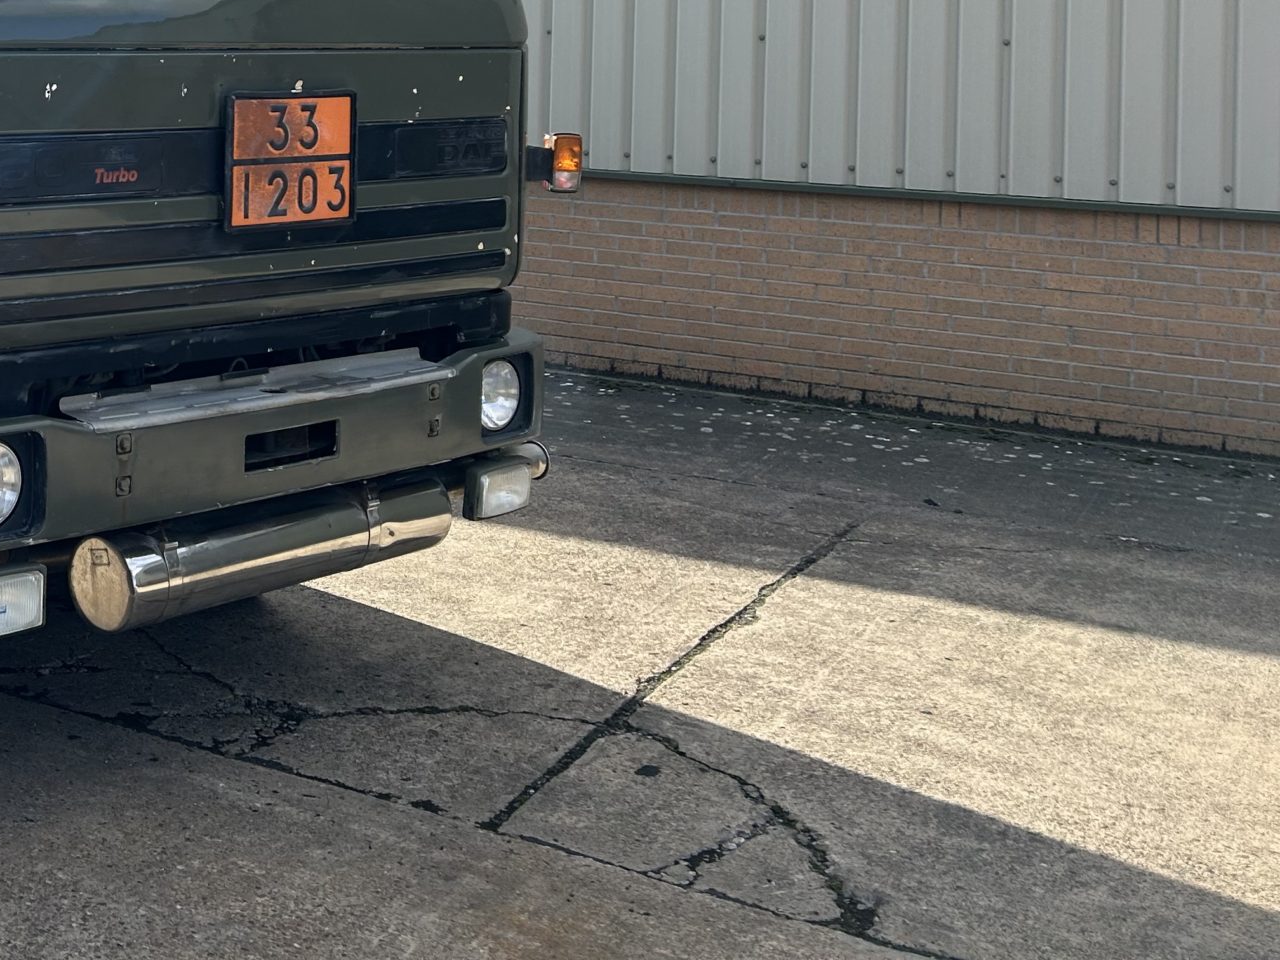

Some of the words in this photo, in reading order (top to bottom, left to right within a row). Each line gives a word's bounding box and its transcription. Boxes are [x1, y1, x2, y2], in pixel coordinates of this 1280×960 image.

[267, 104, 321, 152] 33
[94, 166, 138, 184] Turbo
[241, 165, 348, 220] 1203
